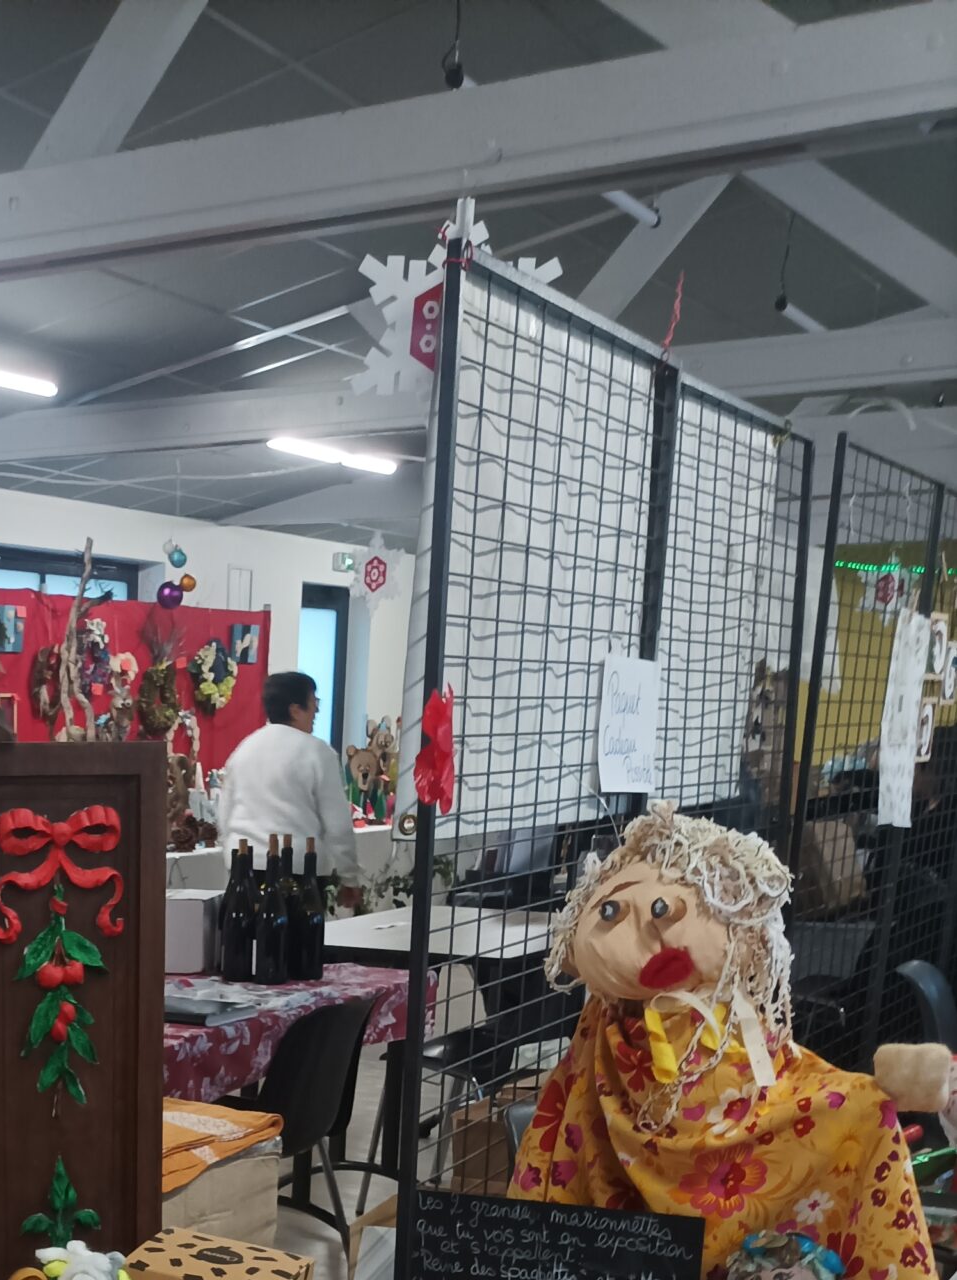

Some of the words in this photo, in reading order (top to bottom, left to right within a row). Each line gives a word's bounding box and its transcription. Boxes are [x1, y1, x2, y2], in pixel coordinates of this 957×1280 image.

[456, 1220, 475, 1240] tu
[483, 1225, 515, 1245] vois
[558, 1232, 587, 1248] en
[470, 1257, 497, 1276] des
